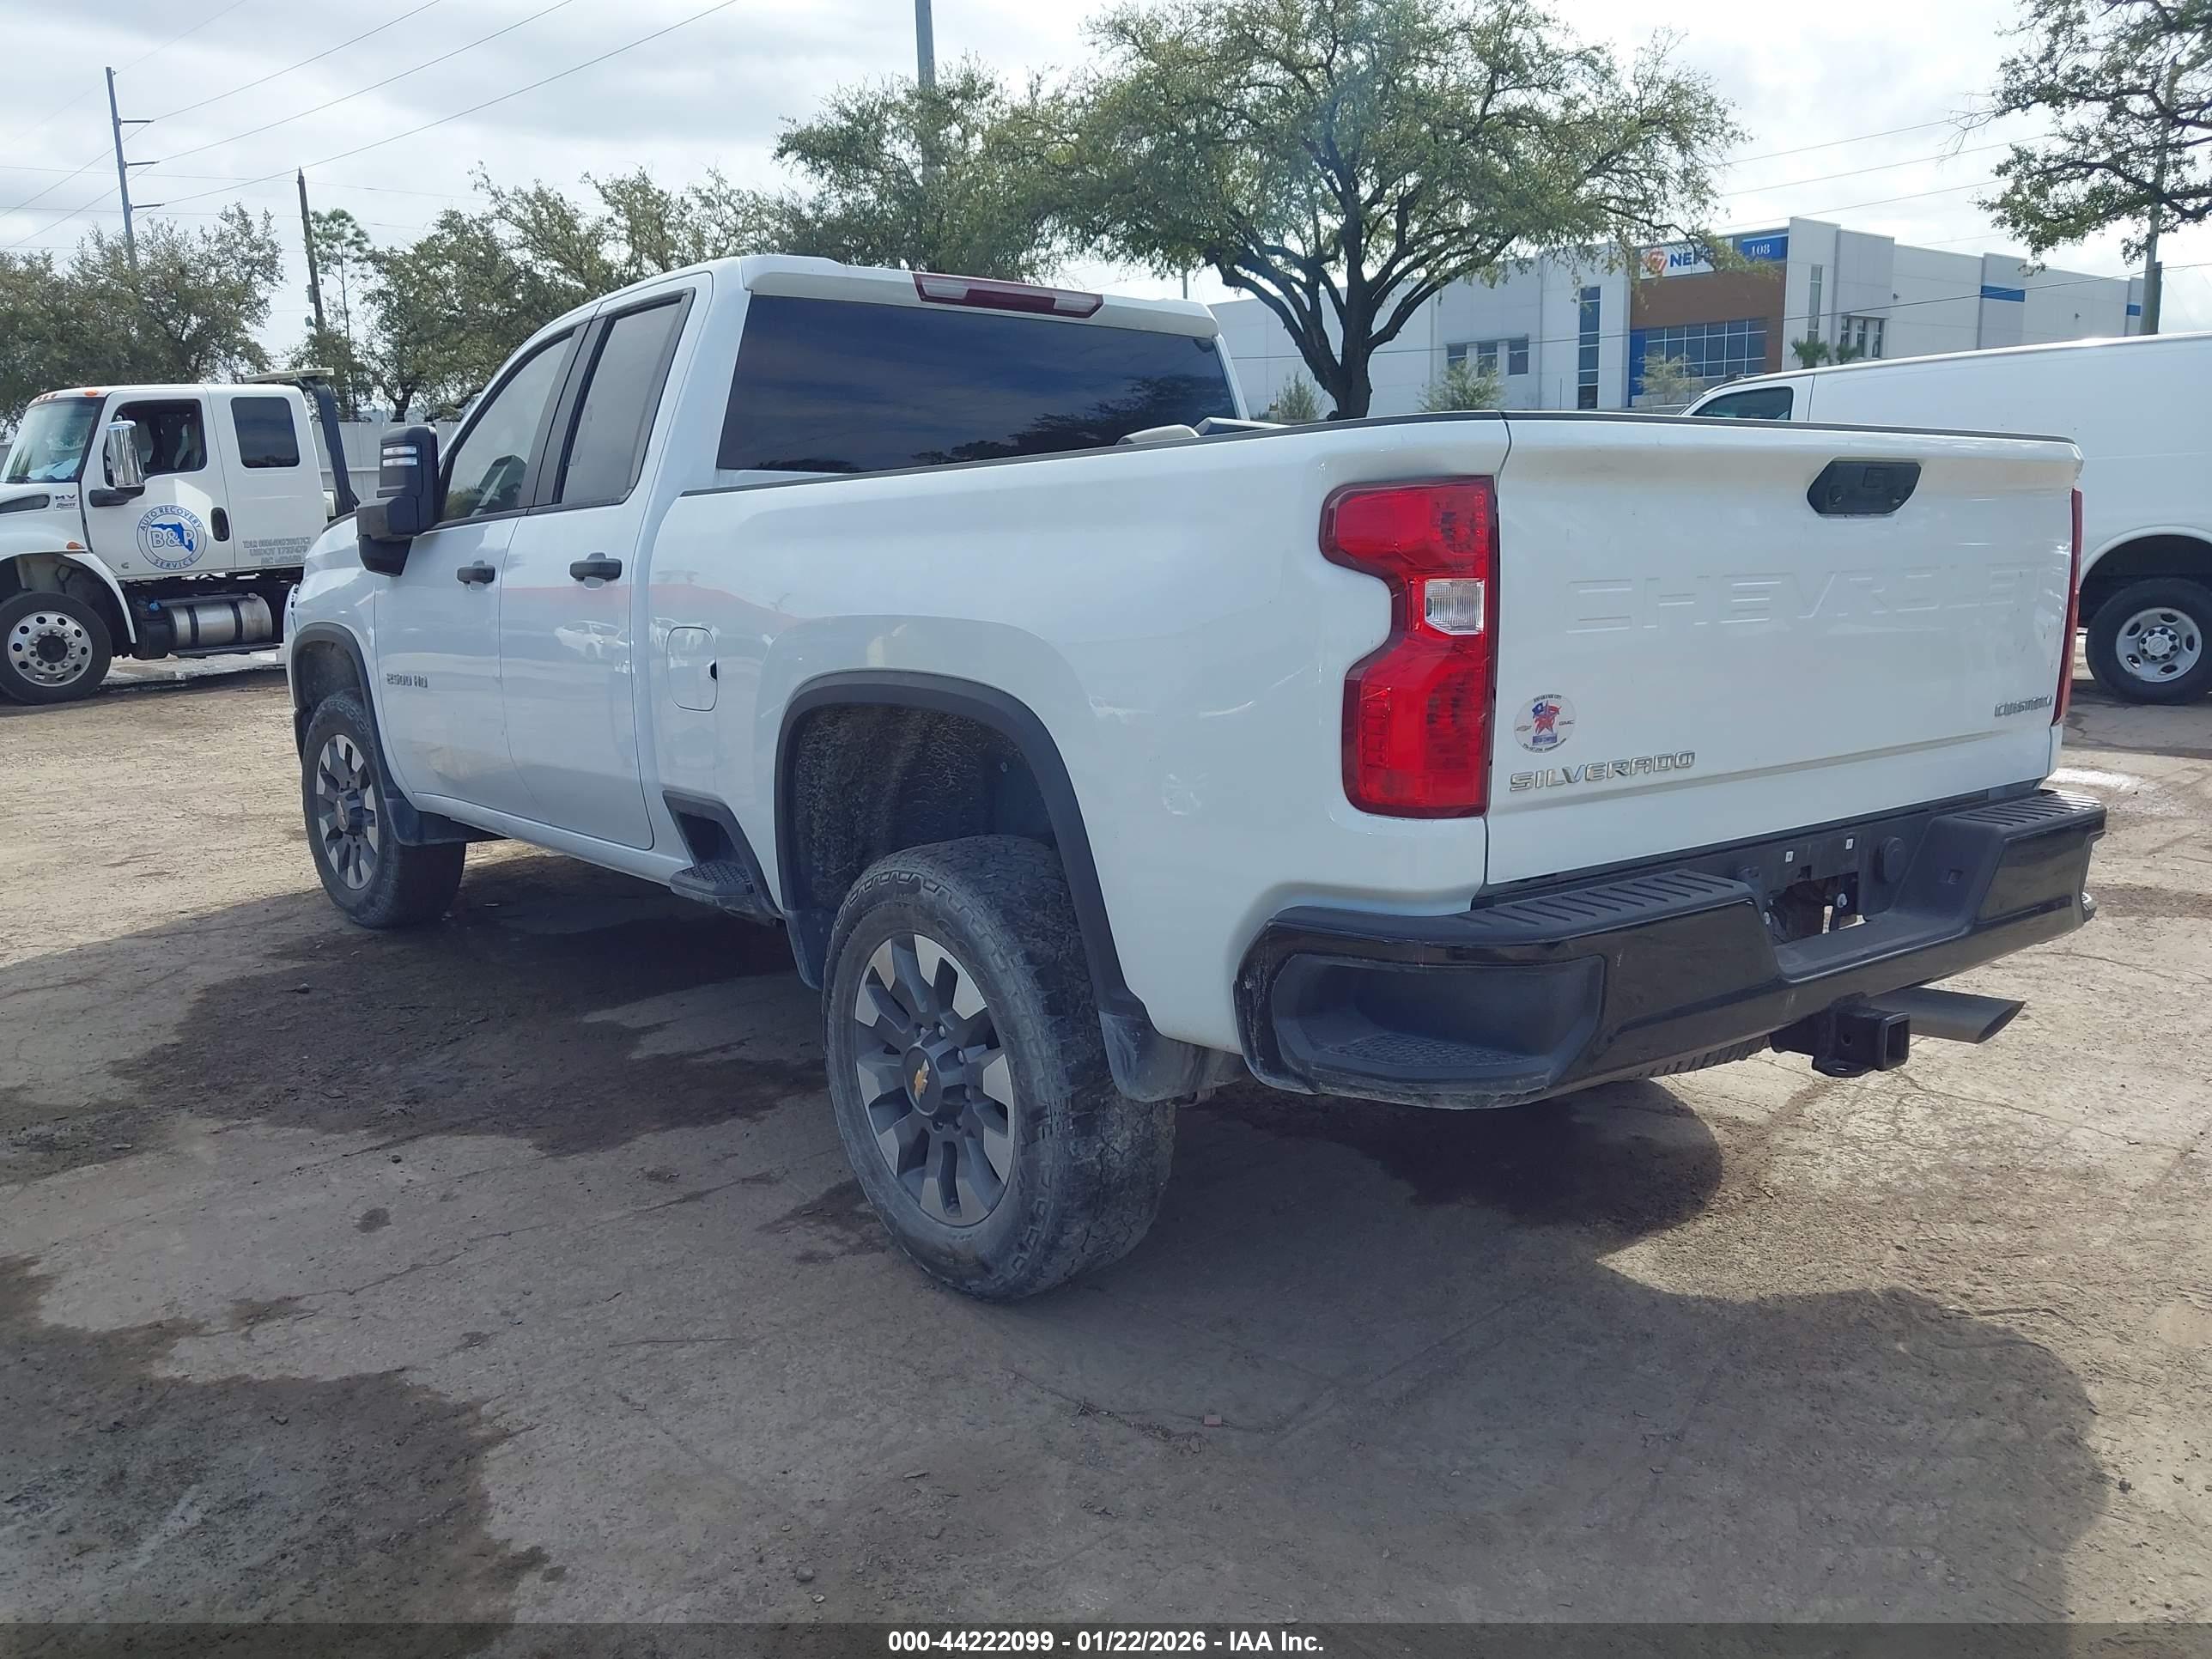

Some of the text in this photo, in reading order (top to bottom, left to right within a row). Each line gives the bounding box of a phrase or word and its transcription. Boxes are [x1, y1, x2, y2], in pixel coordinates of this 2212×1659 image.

[1751, 244, 1771, 256] 108
[140, 507, 203, 532] AUTO RECOVERY
[150, 529, 195, 548] B&P
[154, 556, 194, 569] SERVICE
[386, 672, 428, 689] 2500 HD
[1510, 750, 1696, 793] SILVERADO
